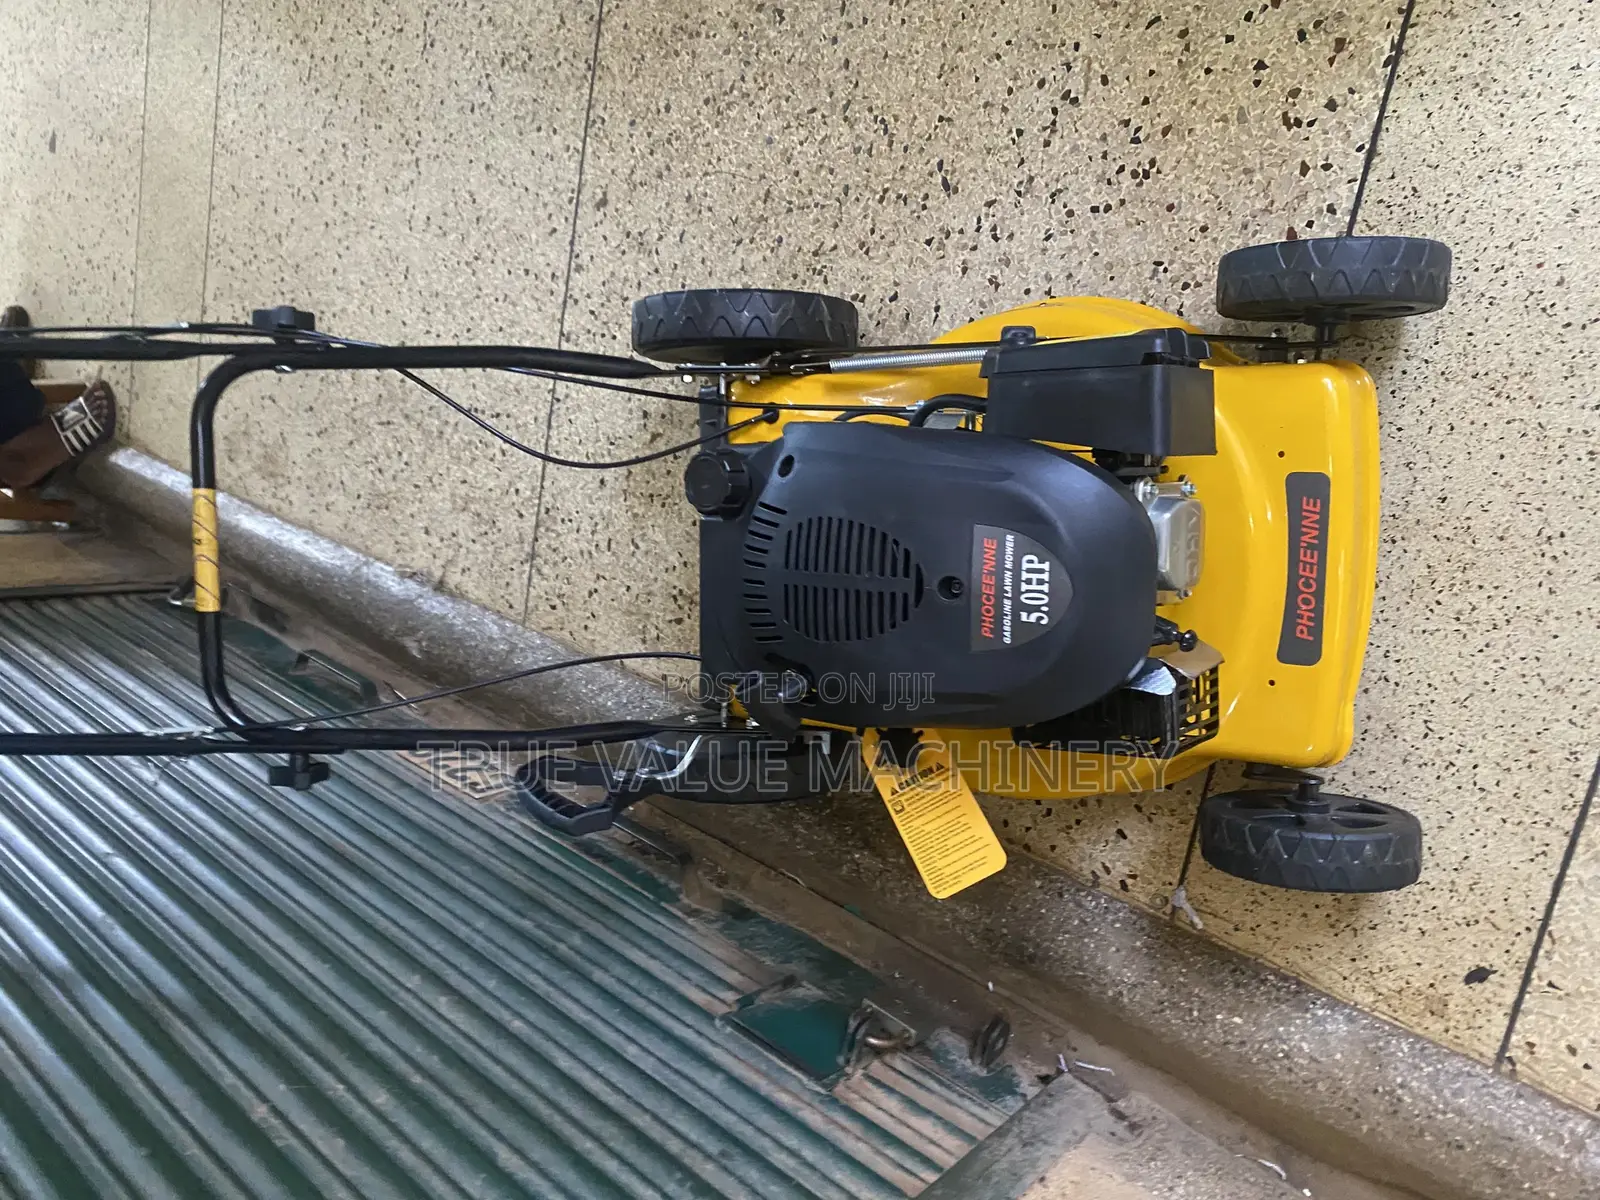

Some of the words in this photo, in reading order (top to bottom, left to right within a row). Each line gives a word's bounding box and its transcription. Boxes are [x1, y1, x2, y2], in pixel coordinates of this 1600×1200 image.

[1003, 570, 1013, 598] LAWN
[1004, 534, 1015, 569] MOWER
[1295, 496, 1321, 641] PHOCEE'NNE
[981, 537, 998, 639] PHOCEE'NNE
[1020, 554, 1050, 625] 5.0HP
